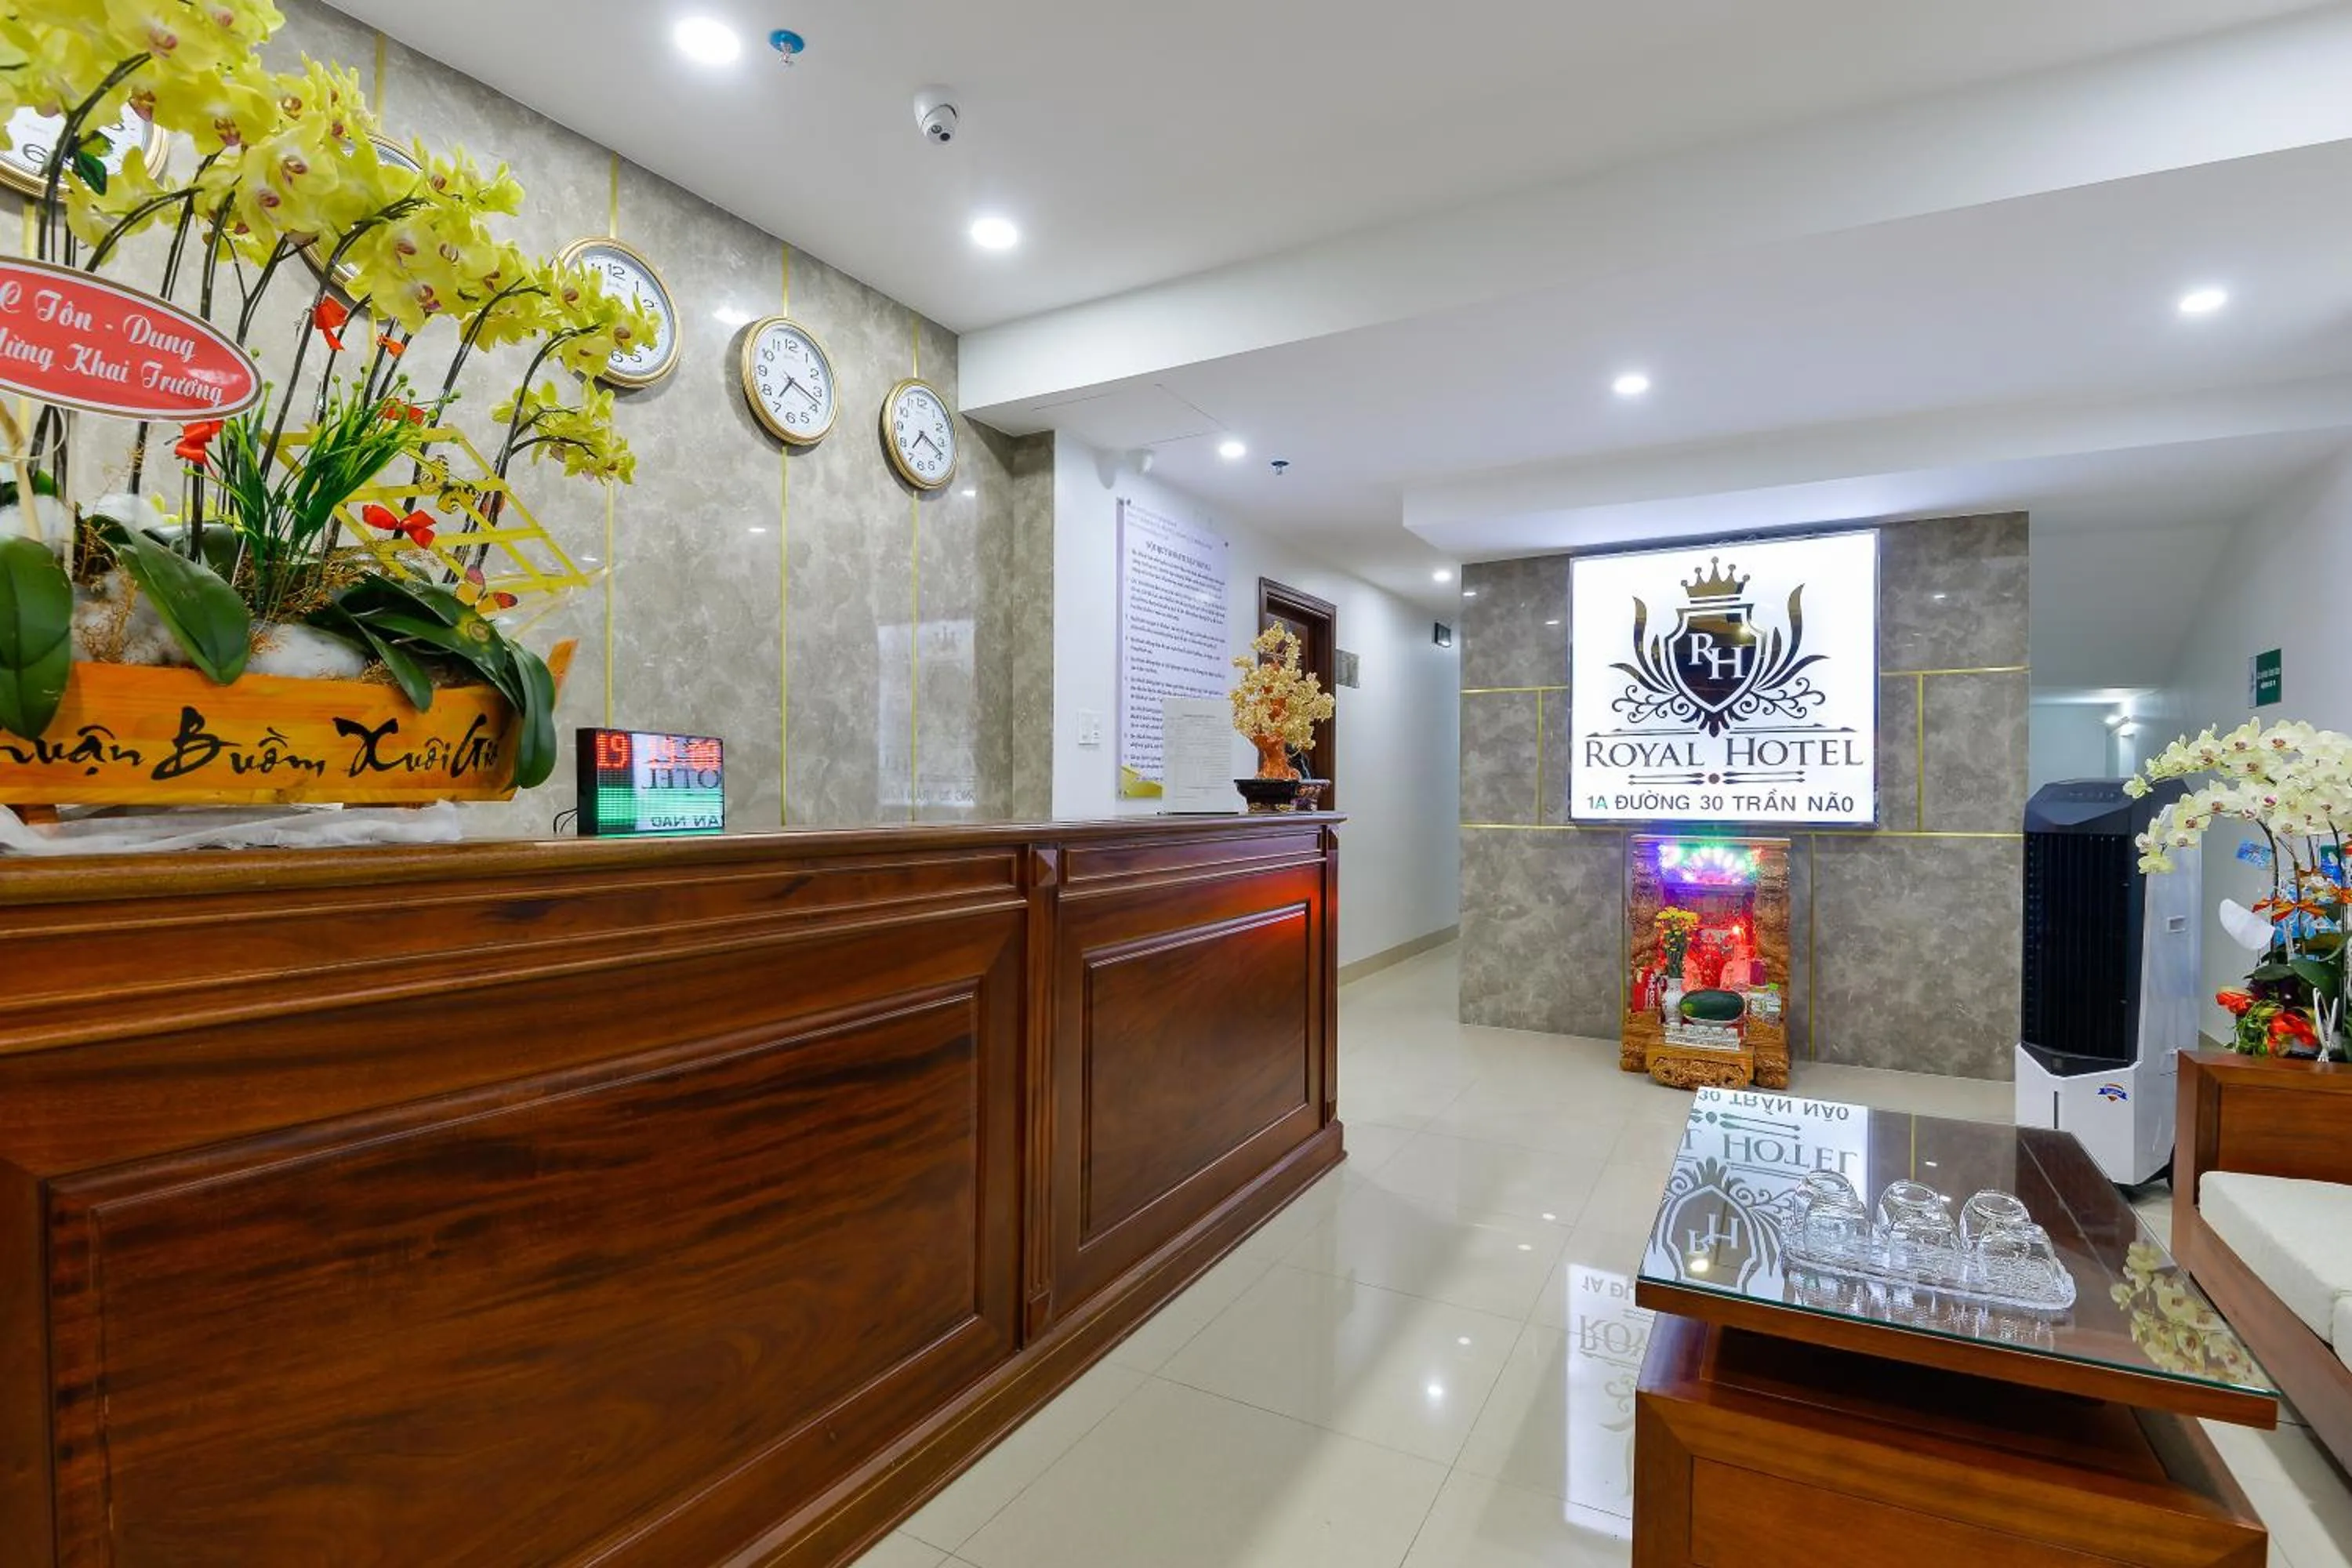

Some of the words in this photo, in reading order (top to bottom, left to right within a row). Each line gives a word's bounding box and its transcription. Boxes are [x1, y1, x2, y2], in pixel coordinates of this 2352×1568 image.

[608, 263, 626, 281] 12
[35, 289, 93, 332] Tôn
[123, 314, 196, 360] Dung
[773, 339, 781, 352] 11
[785, 339, 799, 354] 12
[762, 348, 775, 361] 10
[64, 343, 130, 383] Khai
[757, 365, 768, 376] 9
[811, 368, 819, 380] 2
[762, 383, 772, 396] 8
[813, 386, 822, 397] 3
[772, 401, 782, 413] 7
[907, 397, 914, 409] 11
[916, 397, 927, 409] 12
[786, 412, 796, 424] 6
[800, 412, 810, 424] 5
[896, 420, 904, 431] 9
[935, 423, 943, 433] 2
[899, 437, 907, 448] 8
[938, 437, 945, 448] 3
[908, 452, 915, 463] 7
[916, 460, 924, 470] 6
[927, 460, 935, 470] 5
[151, 706, 325, 780] Buồm
[332, 717, 451, 778] Xuôi
[1584, 739, 1705, 768] ROYAL
[1726, 736, 1864, 768] HOTEL
[1587, 795, 1608, 811] 1A
[1614, 790, 1690, 811] ĐƯỜNG
[1699, 795, 1724, 811] 30
[1732, 788, 1797, 812] TRẦN
